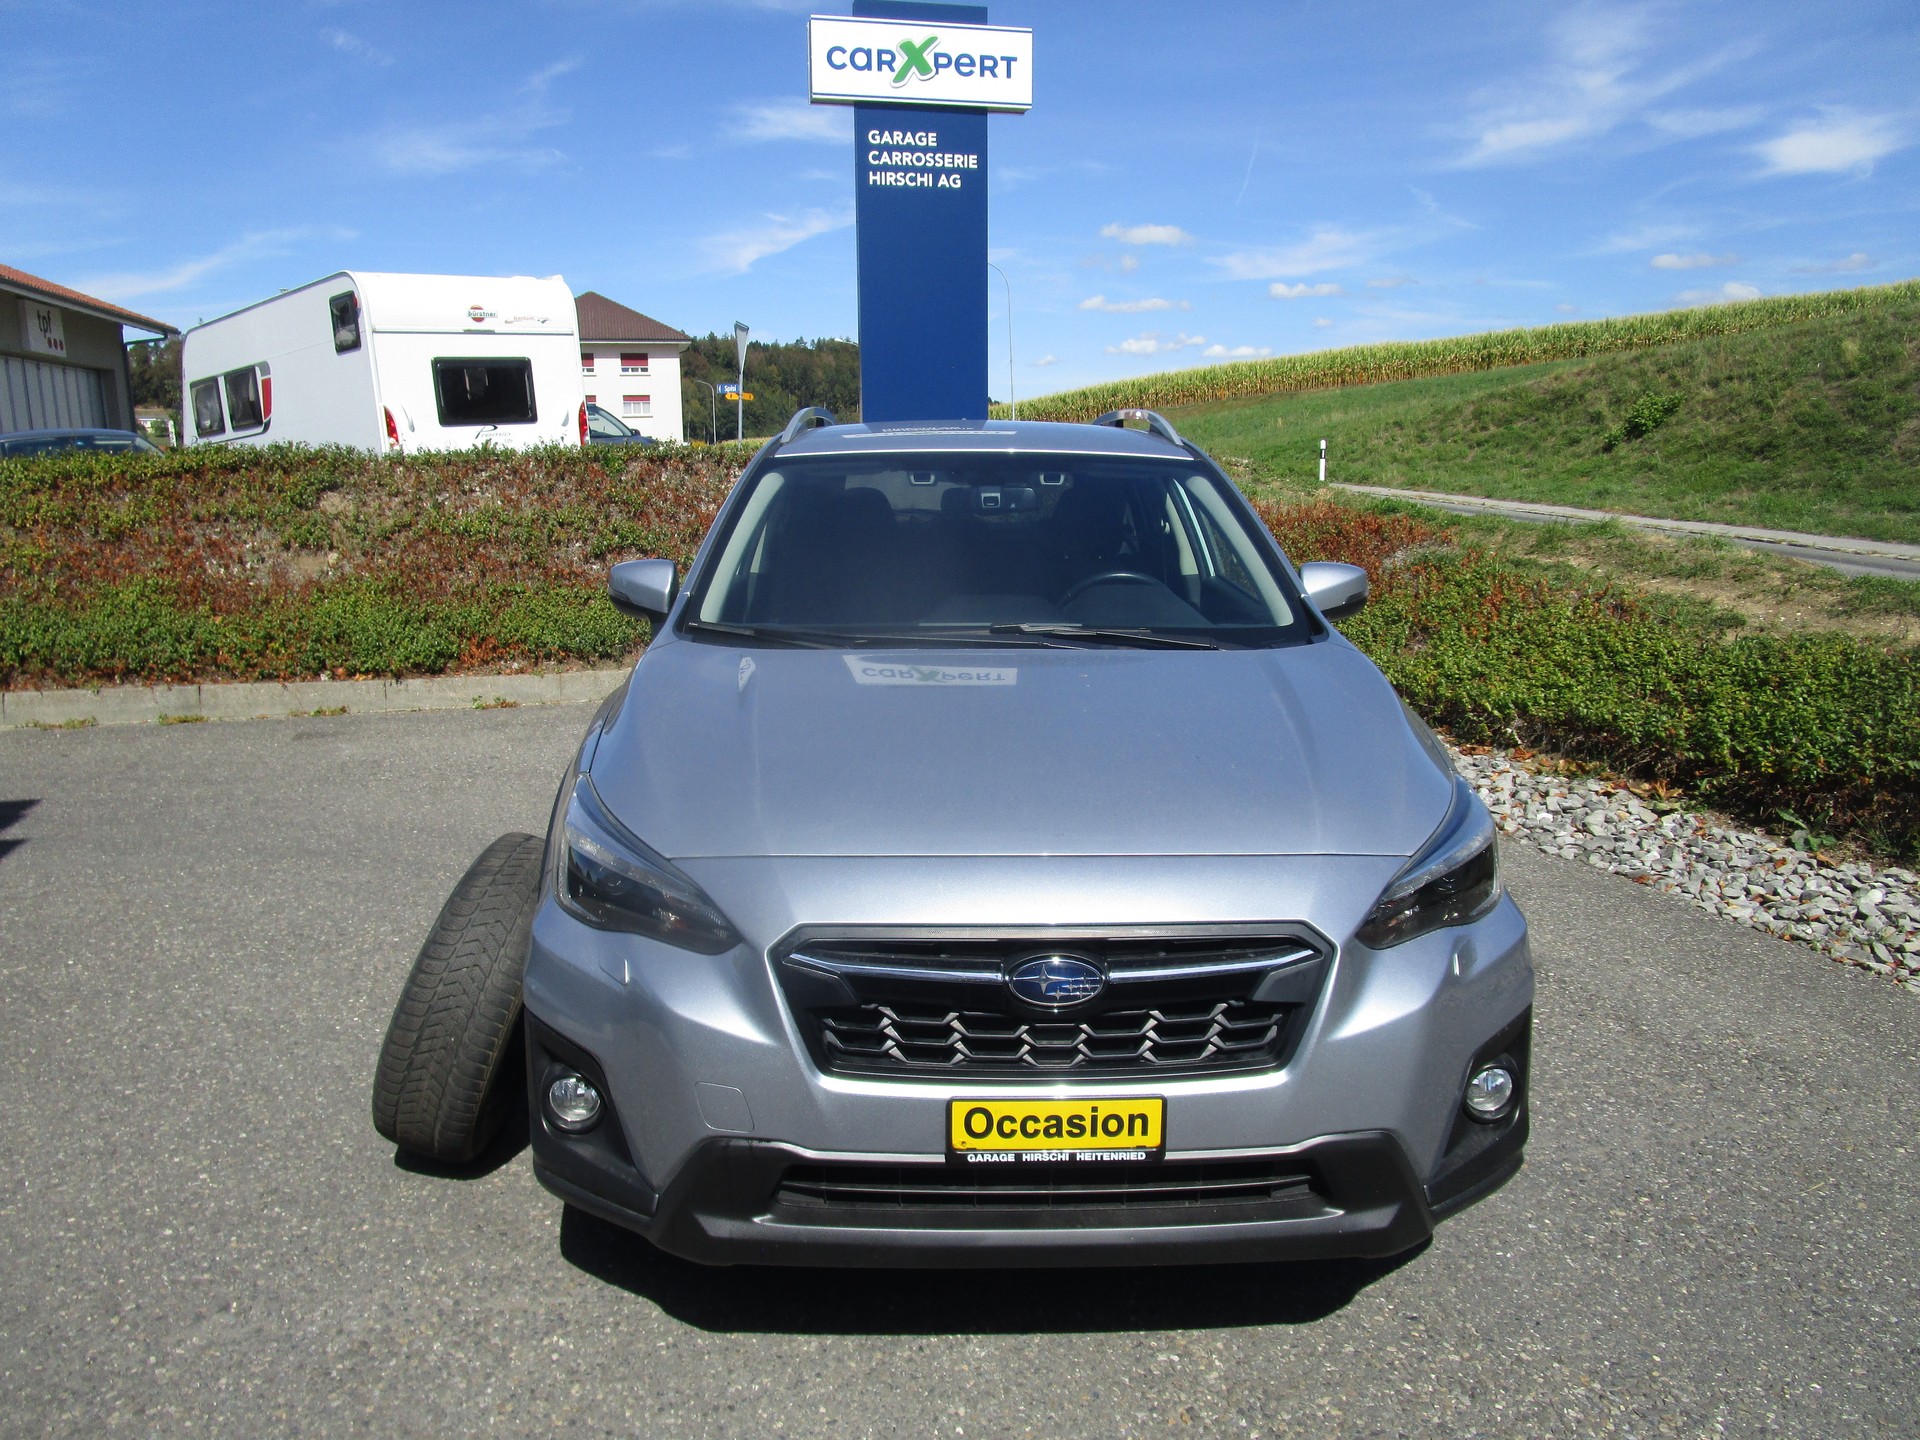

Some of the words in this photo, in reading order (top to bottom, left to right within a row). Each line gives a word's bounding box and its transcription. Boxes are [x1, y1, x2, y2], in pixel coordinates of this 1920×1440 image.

[868, 130, 938, 147] GARAGE
[868, 150, 978, 169] CARROSSERIE
[869, 171, 933, 187] HIRSCHI
[937, 174, 961, 188] AG
[467, 310, 496, 318] bürstner
[37, 310, 52, 339] tpf
[964, 1106, 1149, 1140] Occasion
[967, 1153, 1015, 1162] GARAGE
[1022, 1152, 1069, 1162] HIRSCHI
[1076, 1151, 1146, 1161] HEITENRIED
